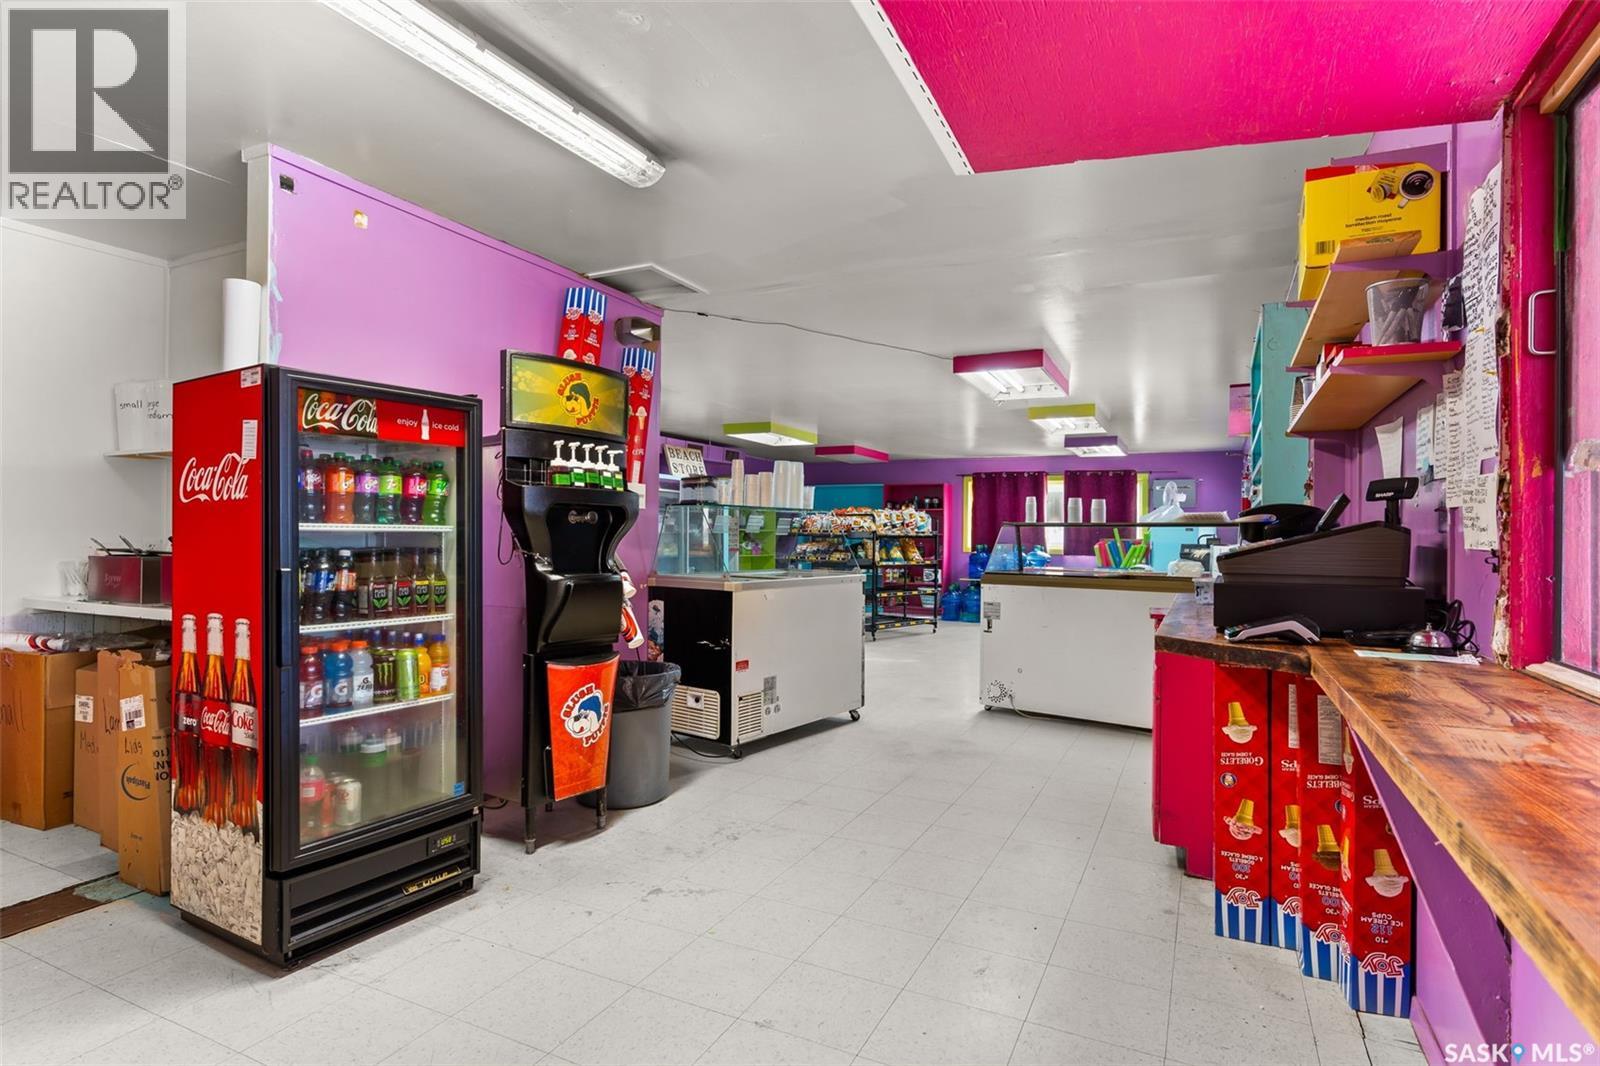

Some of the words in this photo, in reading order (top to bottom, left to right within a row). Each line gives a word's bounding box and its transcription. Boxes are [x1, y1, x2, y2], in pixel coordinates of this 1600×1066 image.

[119, 400, 143, 409] small
[302, 393, 379, 434] Coca-Cola
[397, 417, 418, 428] enjoy
[432, 421, 443, 430] ice
[444, 422, 460, 432] cold
[667, 447, 703, 462] BEACH
[671, 462, 706, 475] STORE
[180, 452, 249, 503] Coca-Cola
[562, 683, 595, 720] SLUSH
[183, 716, 198, 727] zero
[231, 710, 255, 732] Coke
[583, 702, 609, 746] PUPPIE
[1220, 756, 1264, 766] GOBELETS
[1225, 887, 1262, 909] JOY
[1360, 915, 1389, 926] CREAM
[1372, 911, 1393, 920] CUPS
[1390, 920, 1404, 928] ICE
[1361, 952, 1405, 978] JOY
